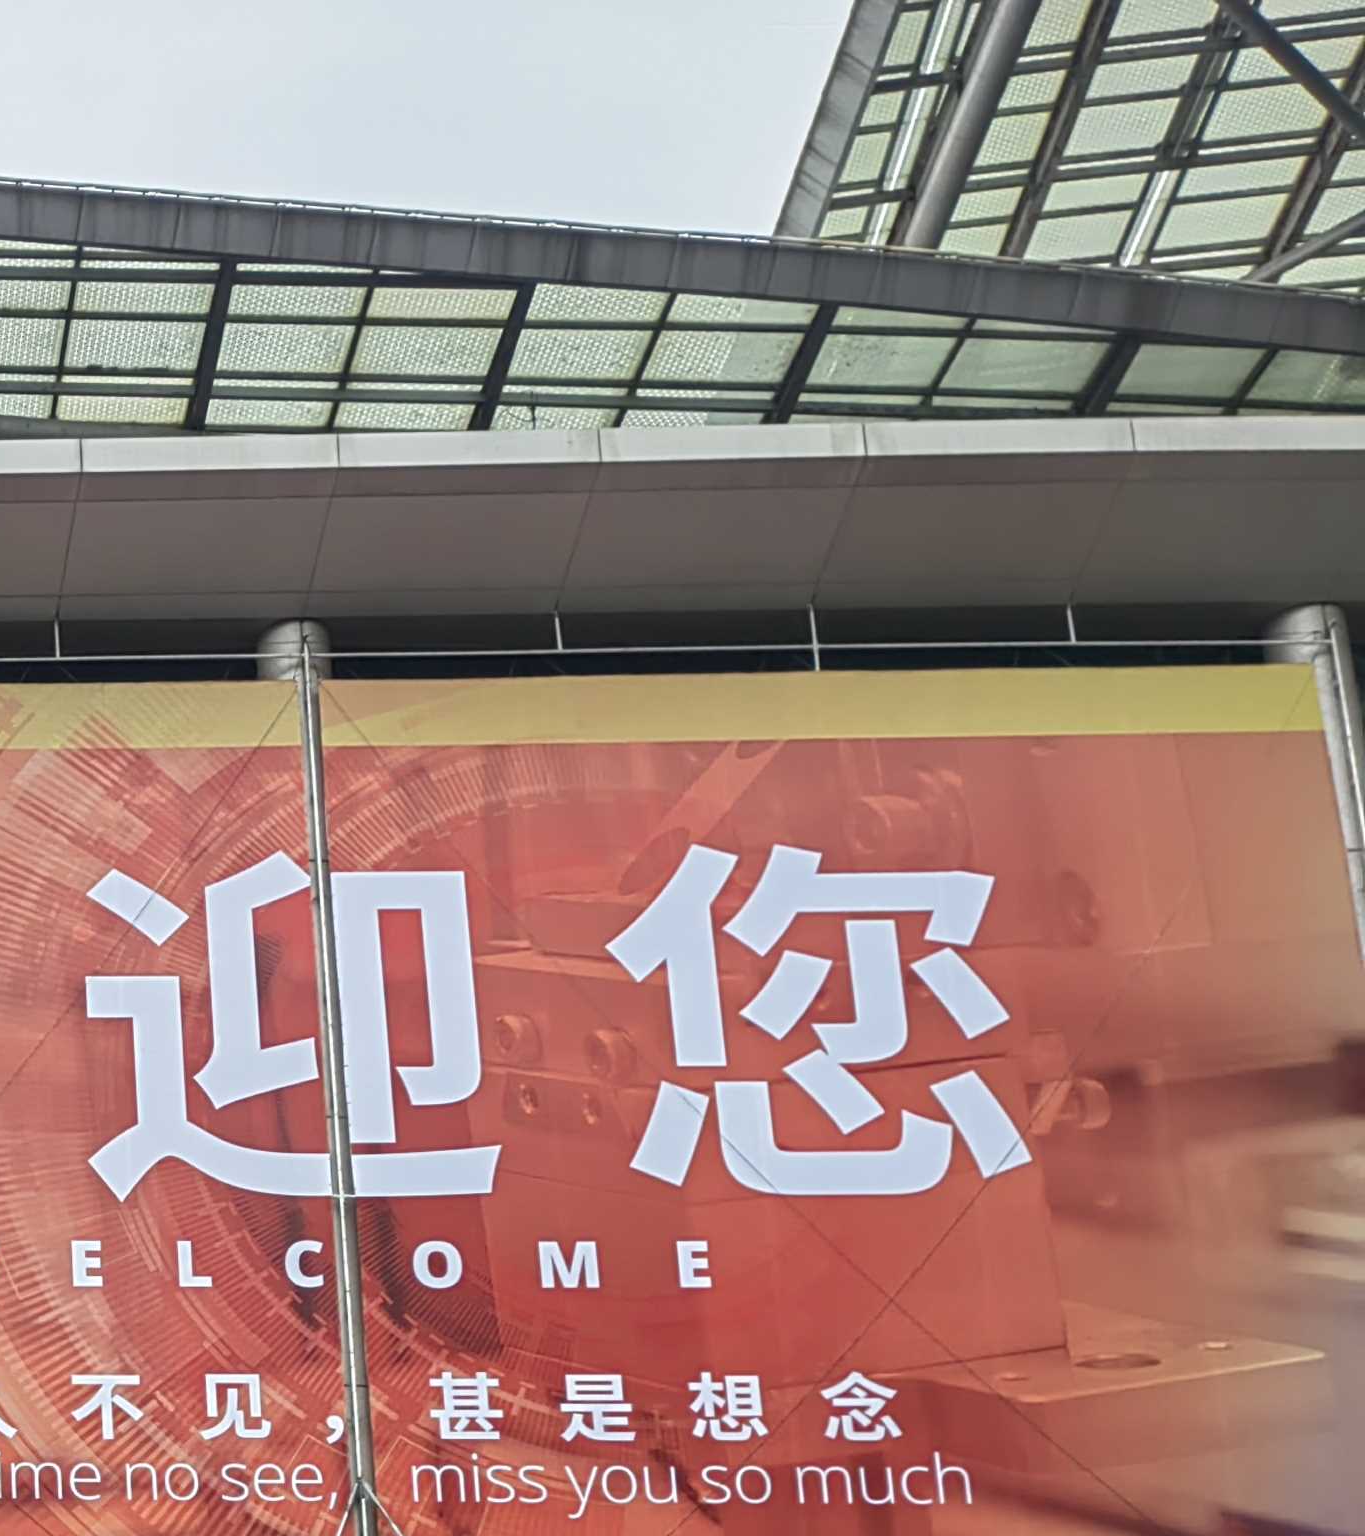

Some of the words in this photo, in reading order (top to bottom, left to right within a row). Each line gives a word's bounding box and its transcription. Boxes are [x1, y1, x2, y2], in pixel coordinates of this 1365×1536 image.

[125, 1461, 200, 1501] no
[221, 1461, 339, 1510] see,
[411, 1452, 548, 1504] miss
[568, 1462, 678, 1519] you
[703, 1463, 772, 1504] so
[796, 1451, 973, 1505] much
